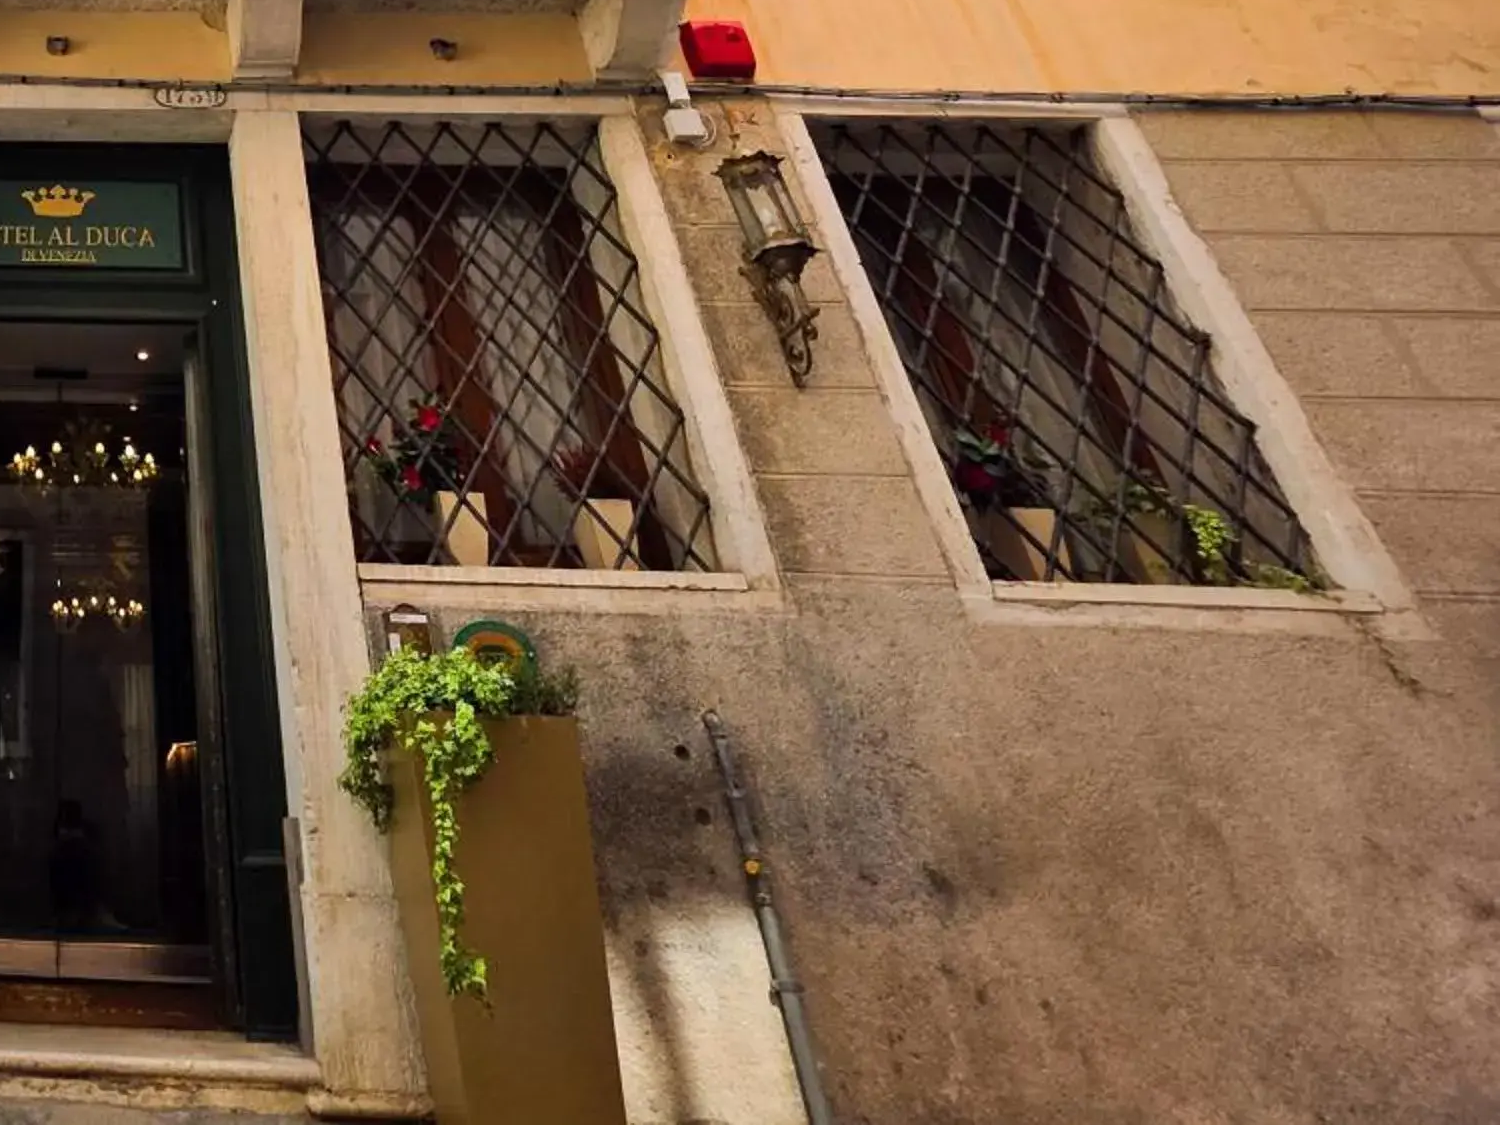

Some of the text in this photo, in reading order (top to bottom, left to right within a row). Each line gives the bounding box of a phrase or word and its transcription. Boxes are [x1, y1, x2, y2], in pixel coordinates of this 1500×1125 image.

[47, 225, 79, 246] AL
[86, 226, 155, 248] DUCA
[37, 248, 97, 263] VENEZIA
